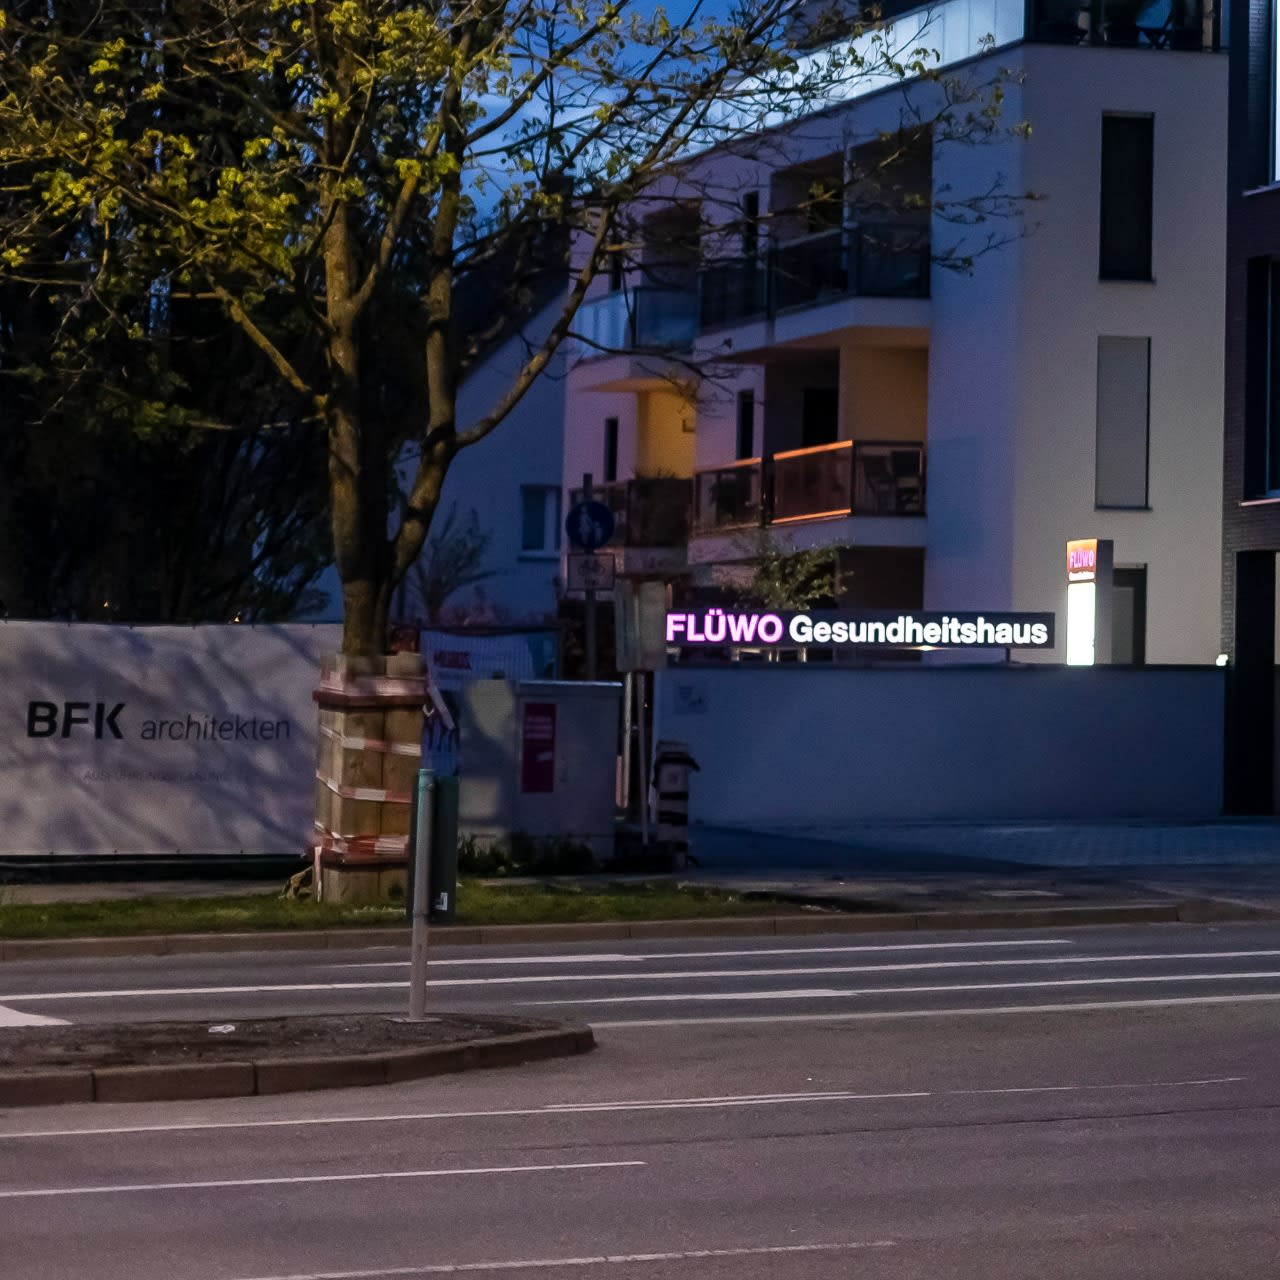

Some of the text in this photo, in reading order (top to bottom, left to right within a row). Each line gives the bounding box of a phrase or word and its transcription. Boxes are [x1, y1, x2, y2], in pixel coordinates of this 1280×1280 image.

[665, 608, 1049, 645] FLÜWO Gesundheitshaus
[27, 700, 291, 741] BFK architekten
